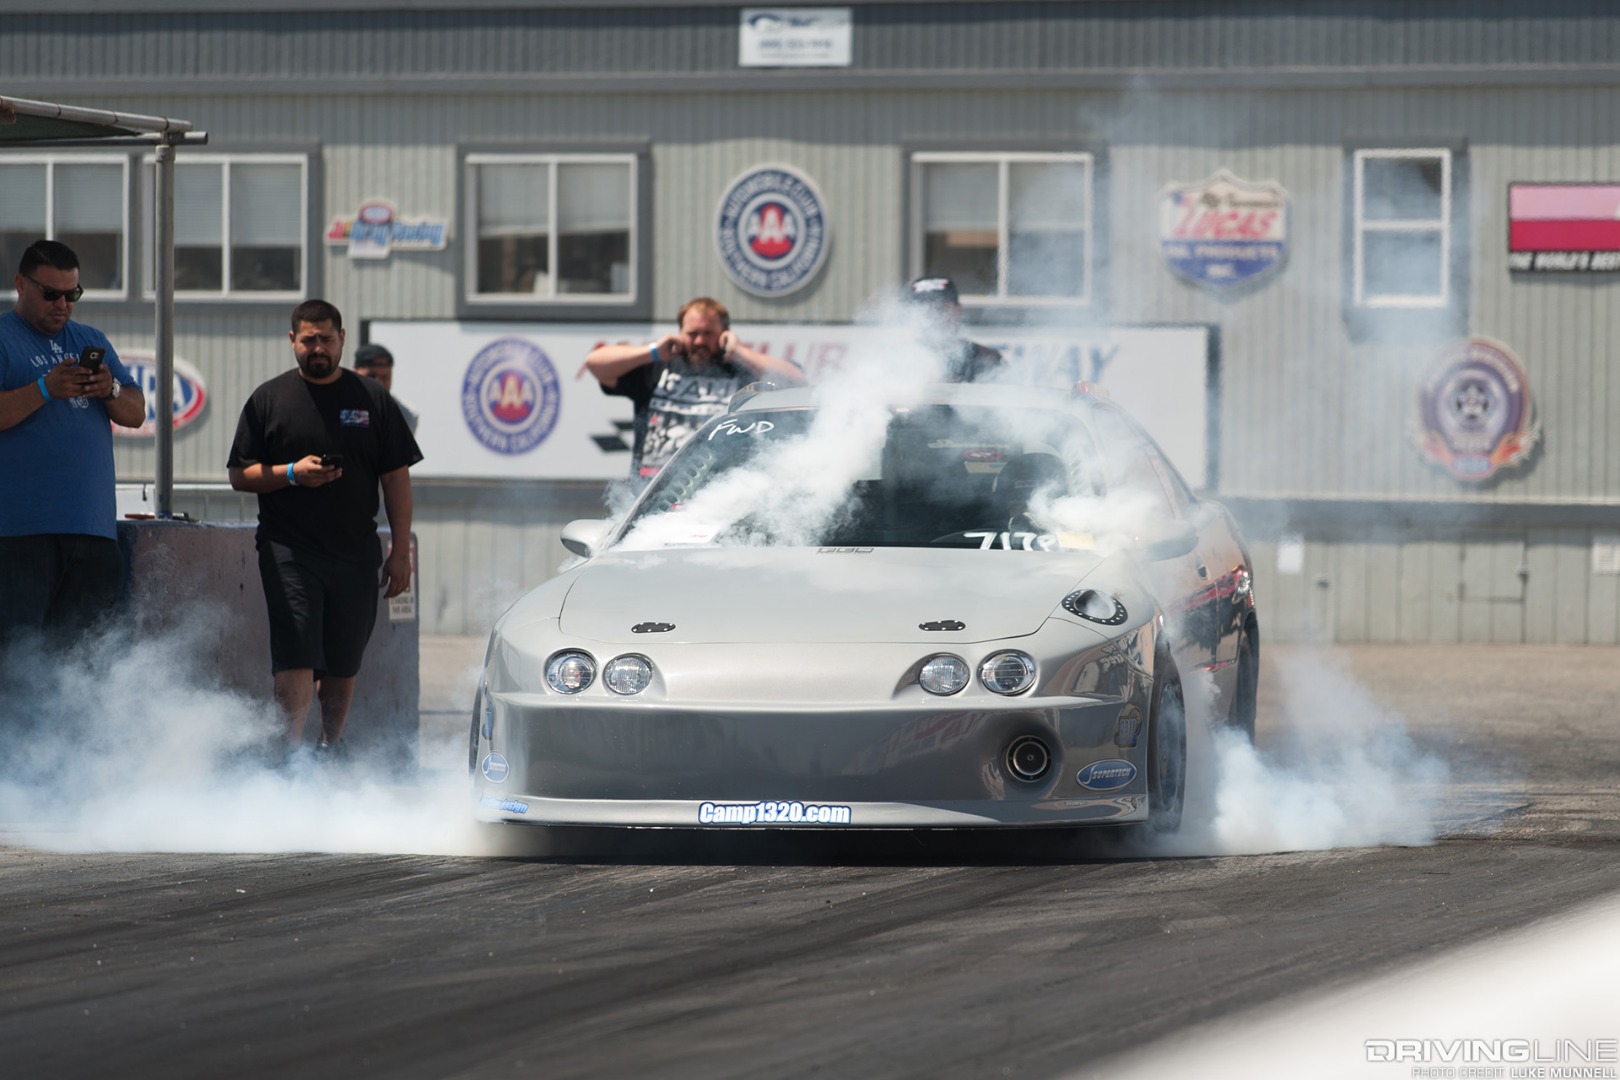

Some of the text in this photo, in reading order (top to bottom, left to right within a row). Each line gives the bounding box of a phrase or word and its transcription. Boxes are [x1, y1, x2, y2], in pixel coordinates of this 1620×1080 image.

[748, 207, 796, 244] AAA
[30, 355, 49, 368] LOS
[489, 374, 533, 408] AAA
[708, 418, 775, 441] FWD
[698, 801, 851, 825] Camp1320.com
